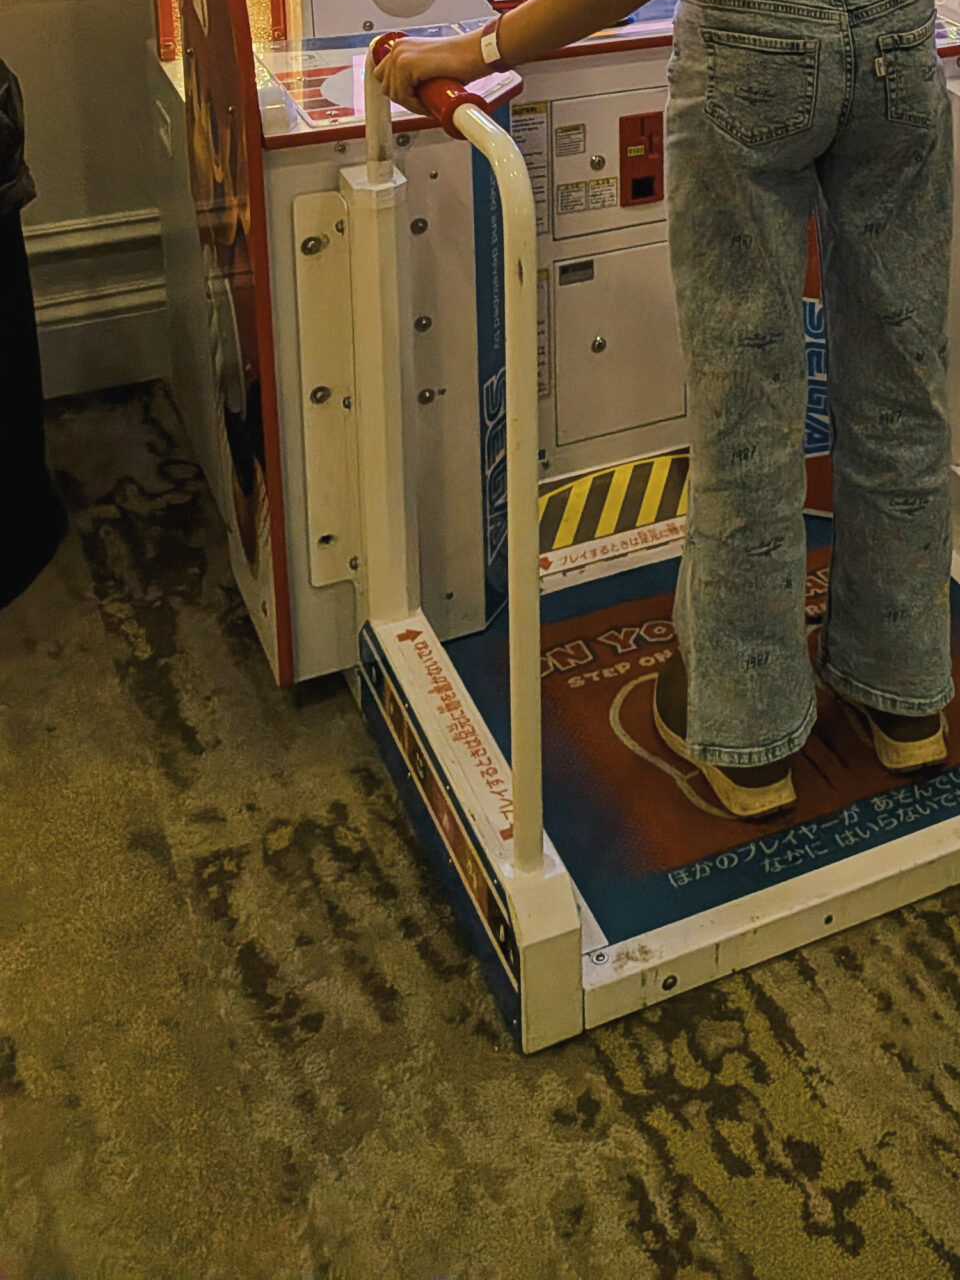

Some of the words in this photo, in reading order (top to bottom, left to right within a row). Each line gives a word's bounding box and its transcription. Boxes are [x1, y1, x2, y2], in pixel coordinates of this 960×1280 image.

[802, 297, 831, 458] SEGA
[483, 366, 509, 566] SEGA
[568, 662, 631, 688] STEP
[639, 649, 673, 667] ON
[762, 842, 829, 874] なかに
